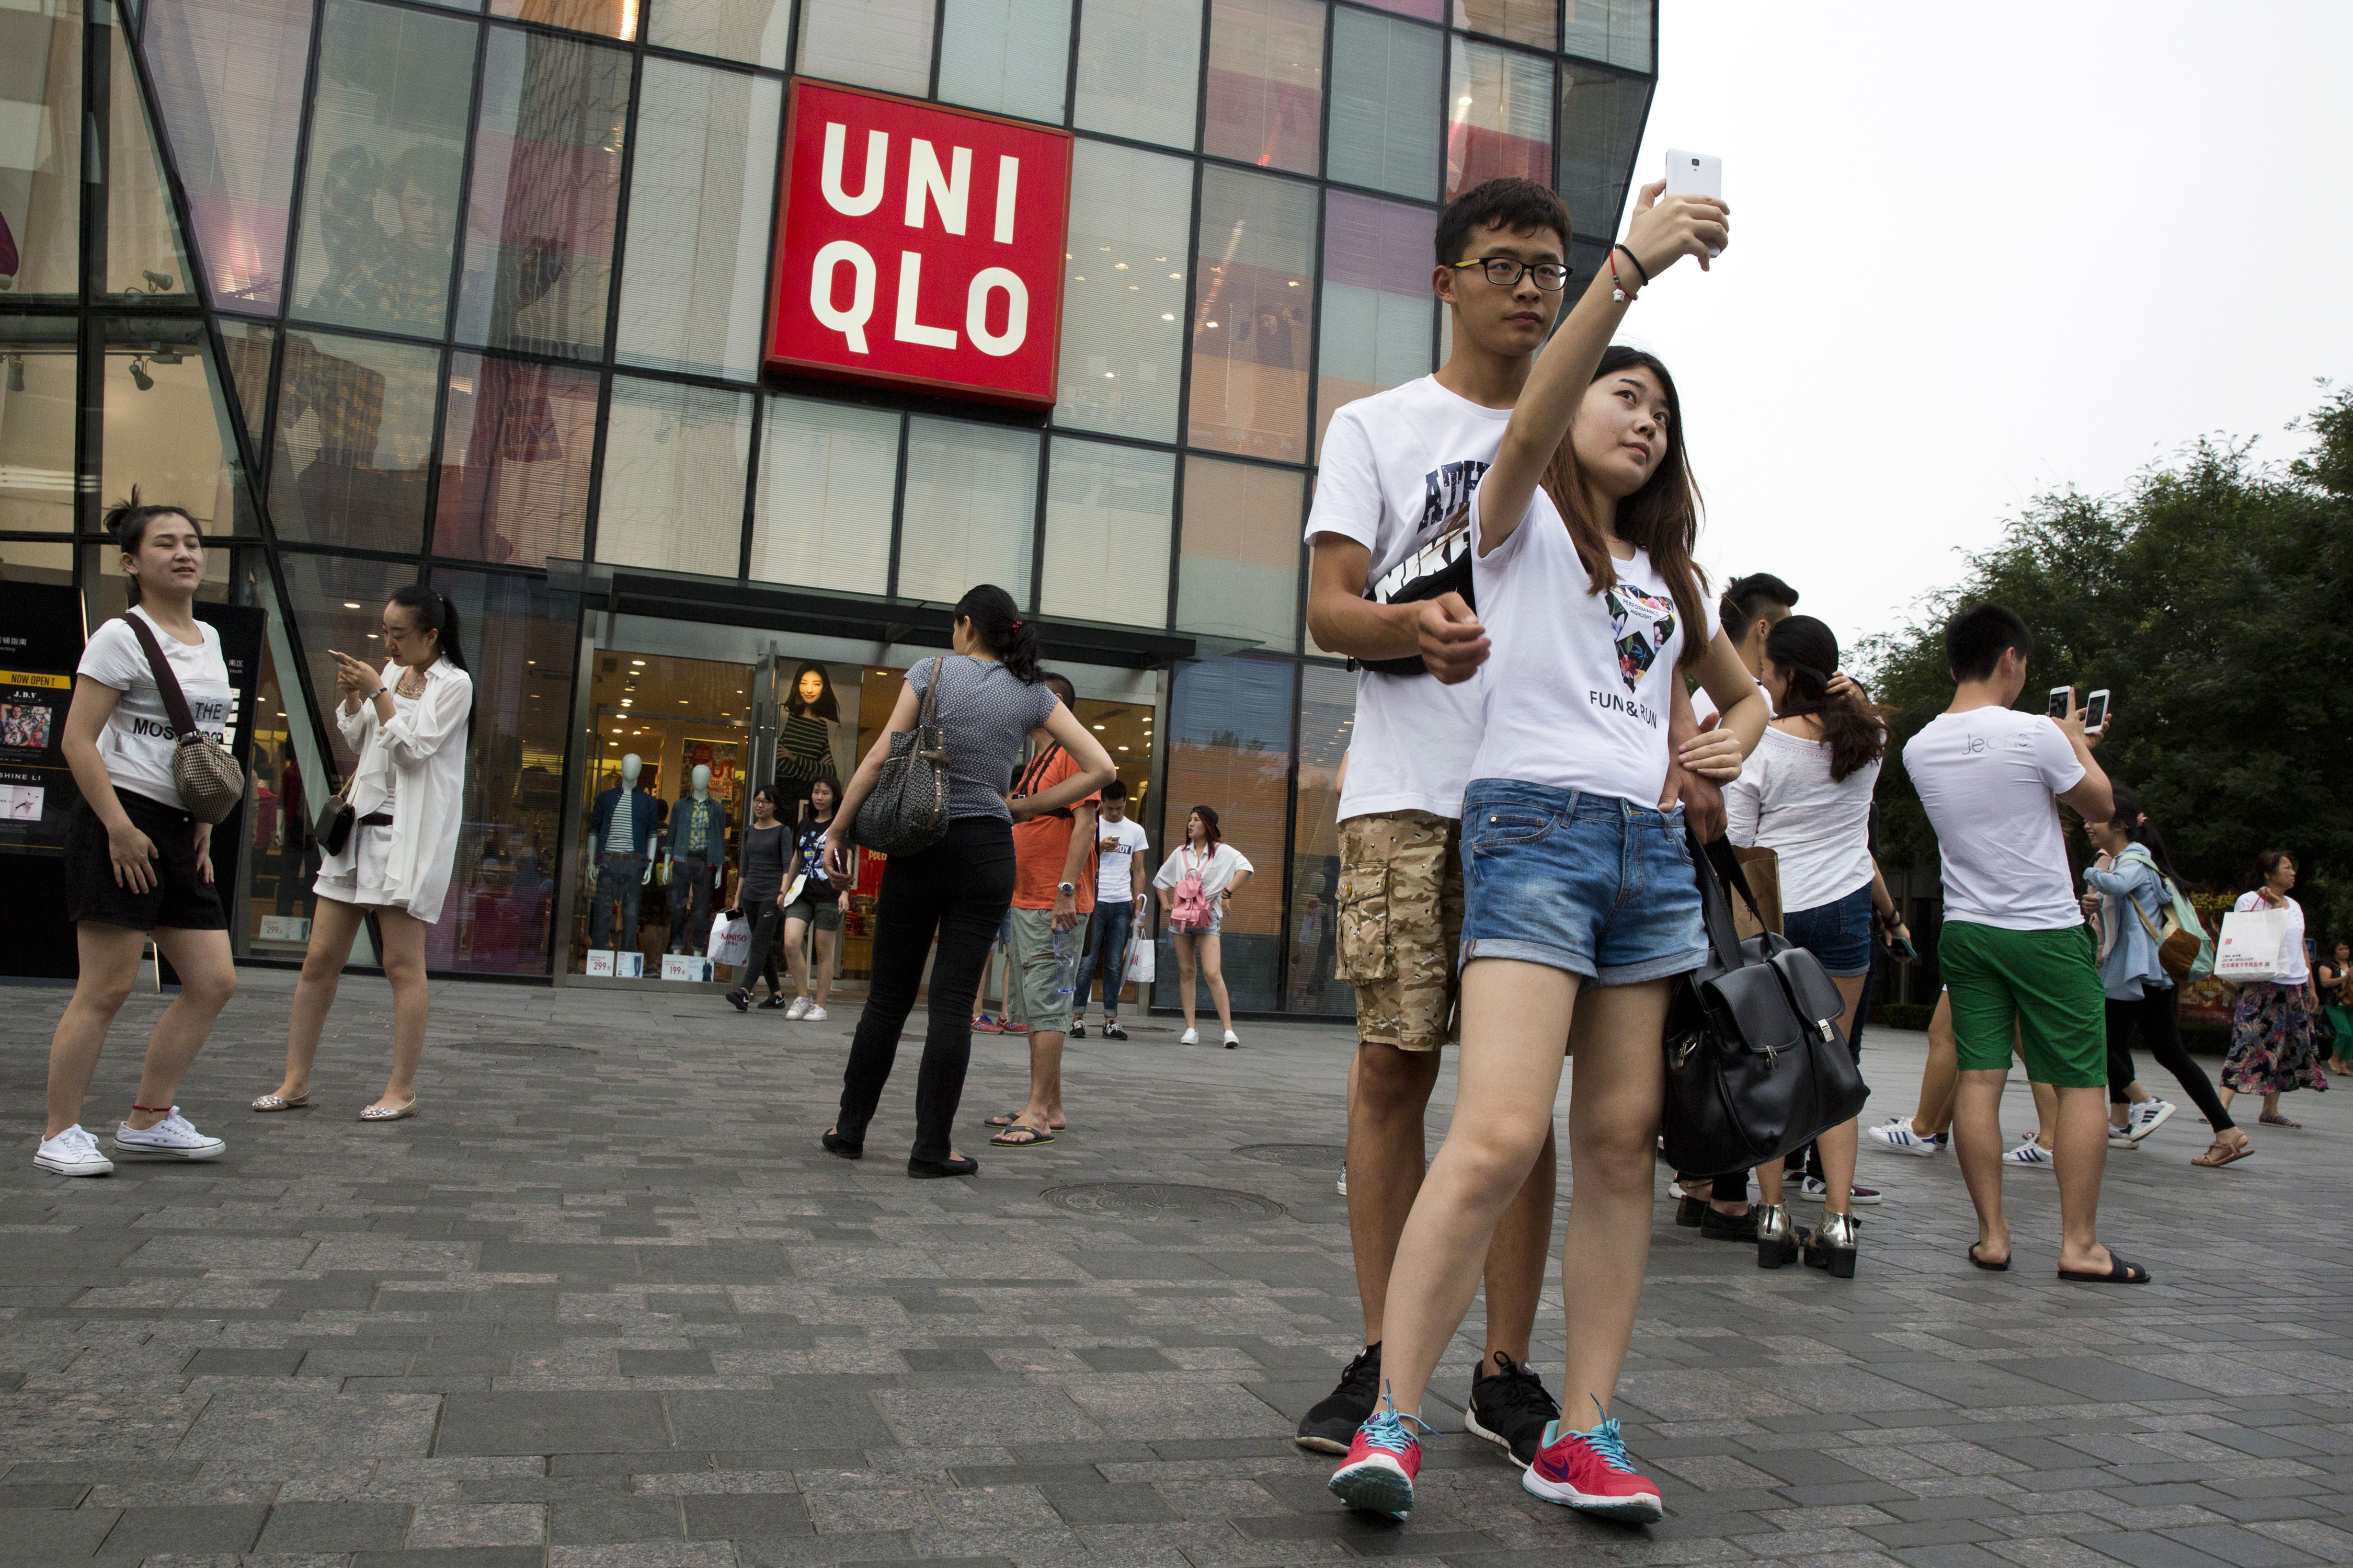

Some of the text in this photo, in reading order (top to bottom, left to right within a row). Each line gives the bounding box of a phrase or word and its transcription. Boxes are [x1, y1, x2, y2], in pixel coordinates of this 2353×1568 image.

[821, 121, 1019, 245] UNI
[810, 240, 1029, 357] QLO
[1417, 460, 1490, 535] ATH
[1623, 599, 1659, 616] PERFORMANCE
[1630, 609, 1652, 620] HIGHLIGHT
[0, 637, 27, 646] 铺指南
[11, 674, 29, 684] NOW
[30, 676, 50, 686] OPEN
[196, 702, 222, 719] THE
[1366, 1412, 1381, 1425] NIKE
